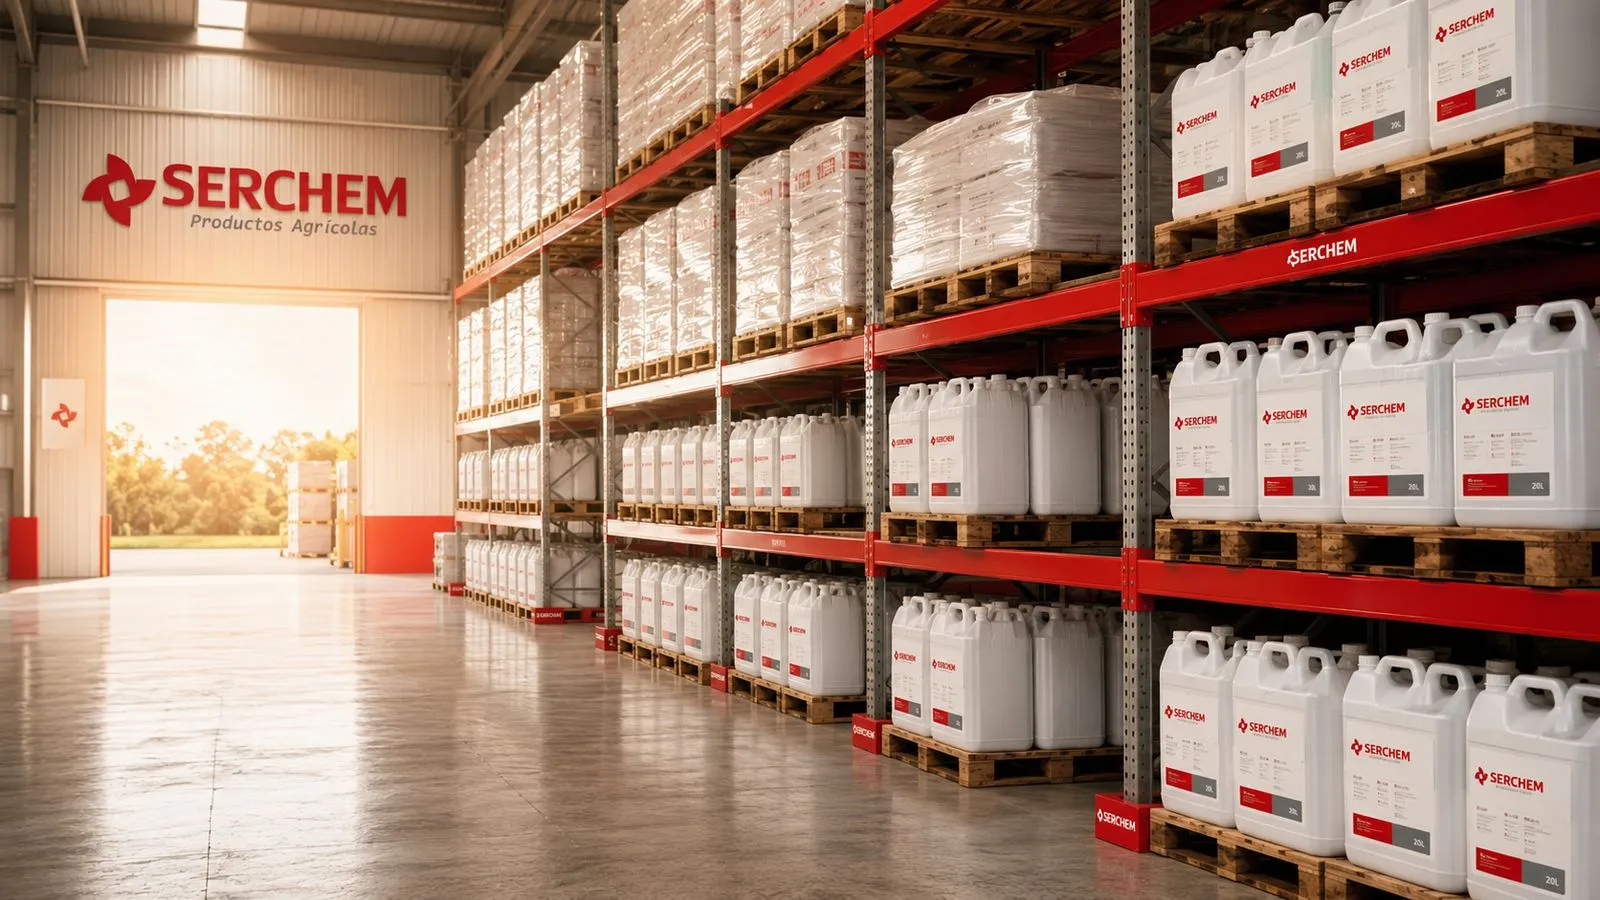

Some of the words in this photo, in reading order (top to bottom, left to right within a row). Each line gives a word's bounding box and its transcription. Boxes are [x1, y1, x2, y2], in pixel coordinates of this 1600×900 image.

[1449, 8, 1494, 35] SERCHEM
[1350, 46, 1391, 70] SERCHEM
[1261, 81, 1296, 102] SERCHEM
[1186, 111, 1217, 129] SERCHEM
[162, 164, 408, 217] SERCHEM
[190, 214, 283, 232] Productos
[291, 218, 378, 237] Agrícolas
[1290, 238, 1357, 265] SERCHEM
[1360, 402, 1405, 416] SERCHEM
[1476, 394, 1529, 409] SERCHEM
[1184, 415, 1218, 426] SERCHEM
[1272, 409, 1308, 421] SERCHEM
[1531, 482, 1545, 490] 20L
[1174, 708, 1206, 722] SERCHEM
[1249, 721, 1287, 738] SERCHEM
[1364, 743, 1411, 762] SERCHEM
[1490, 772, 1544, 794] SERCHEM
[1103, 811, 1137, 833] SERCHEM
[1545, 875, 1560, 887] 20L
